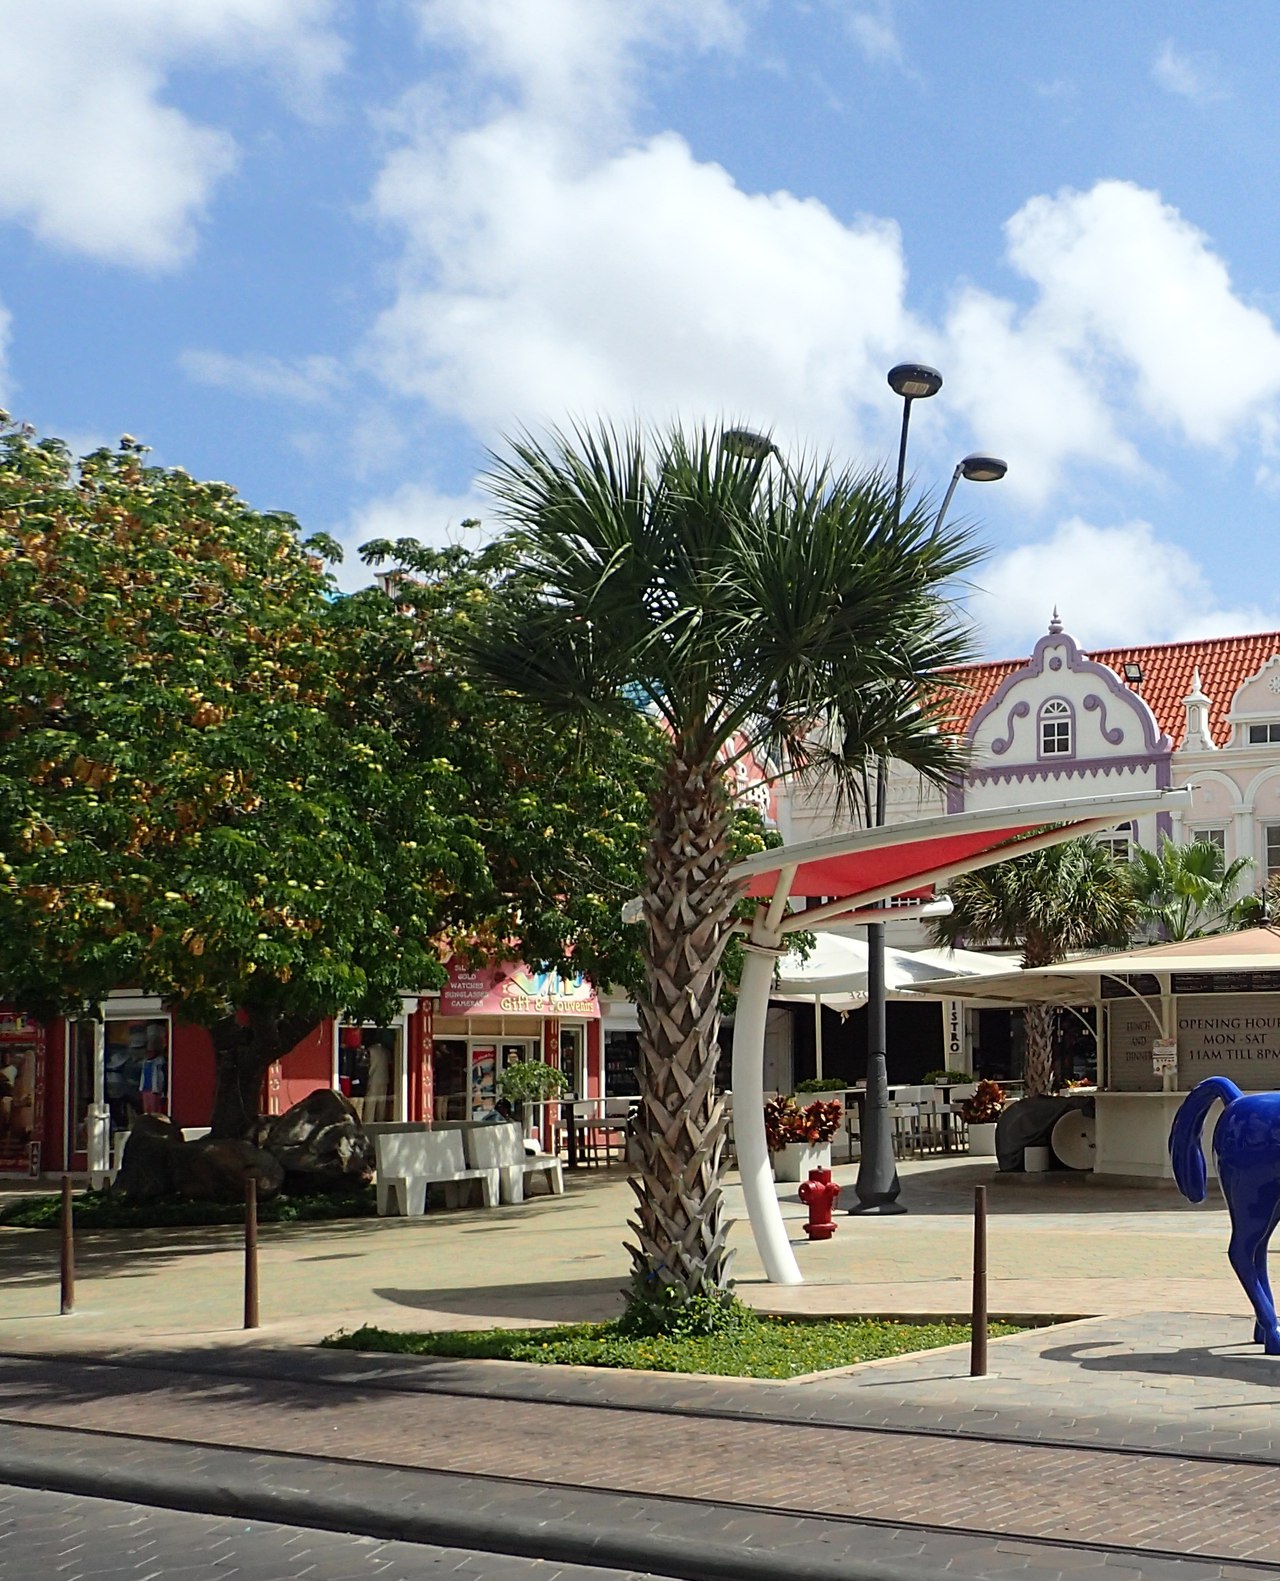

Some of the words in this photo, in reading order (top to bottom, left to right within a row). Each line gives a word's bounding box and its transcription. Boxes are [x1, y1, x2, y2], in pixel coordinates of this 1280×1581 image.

[500, 995, 531, 1012] Gift
[535, 998, 545, 1011] &
[1179, 1018, 1240, 1029] OPENING
[1203, 1033, 1236, 1044] MON
[1189, 1050, 1222, 1060] 11AM
[1226, 1050, 1252, 1060] TILL
